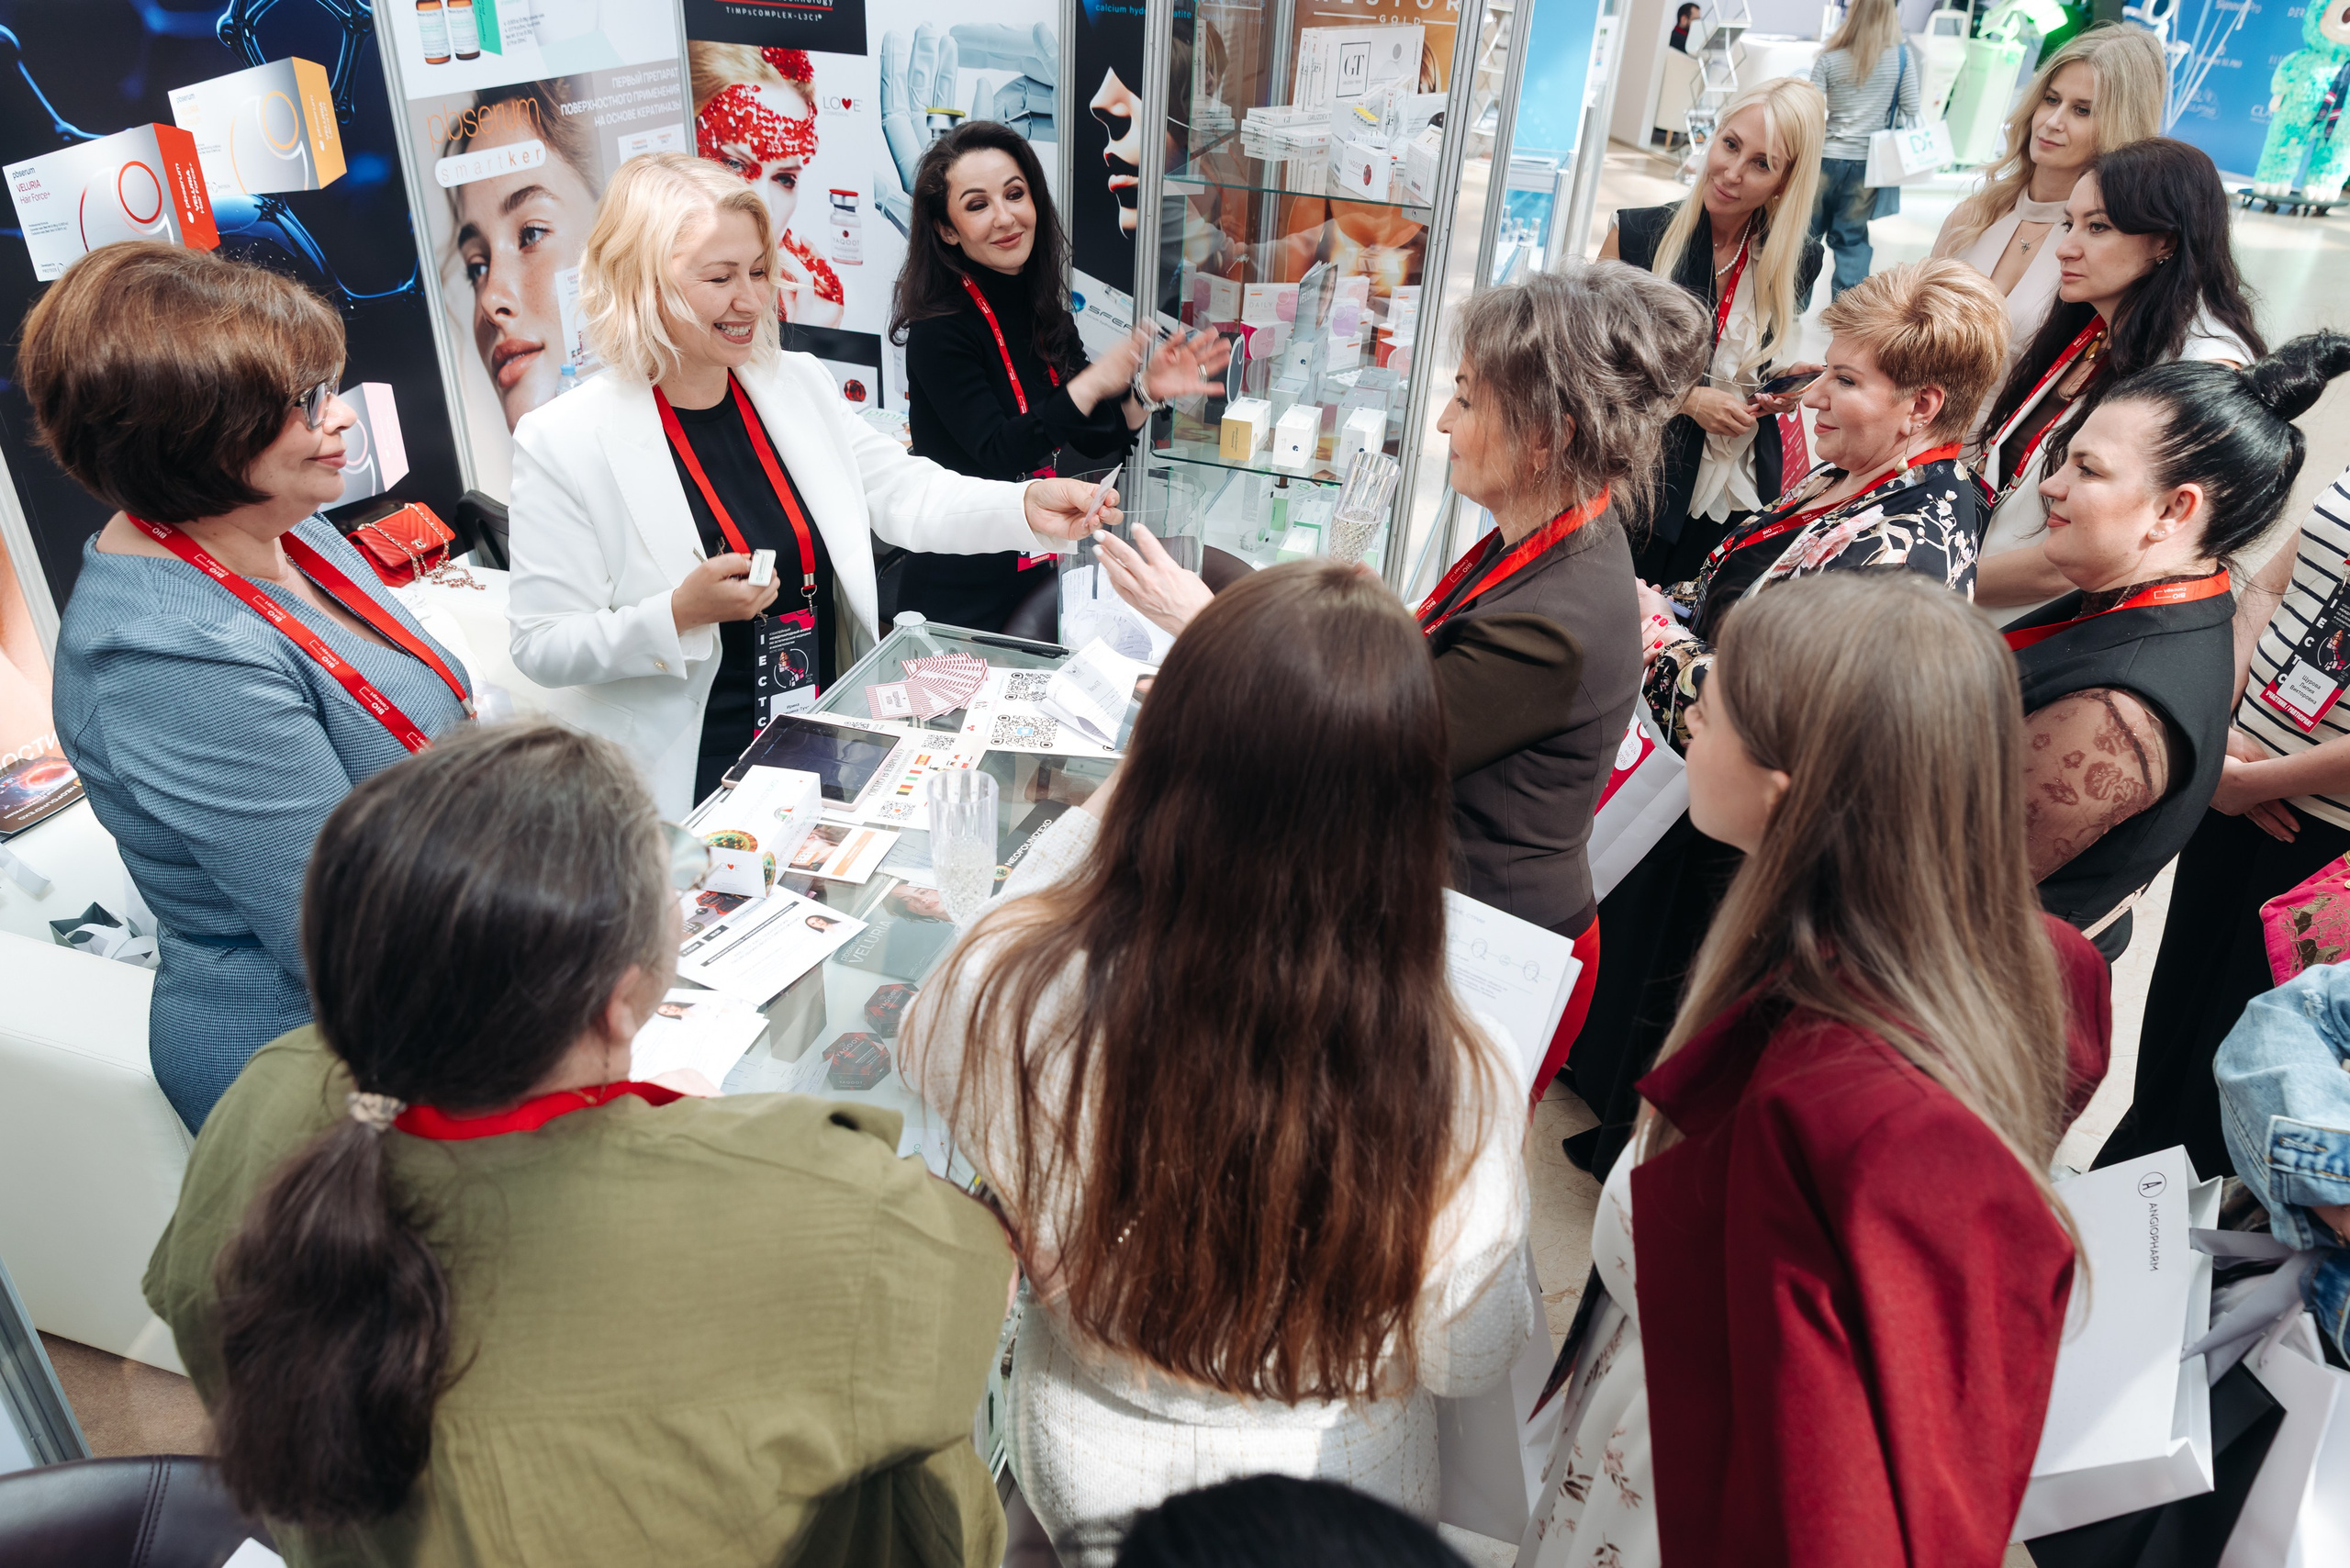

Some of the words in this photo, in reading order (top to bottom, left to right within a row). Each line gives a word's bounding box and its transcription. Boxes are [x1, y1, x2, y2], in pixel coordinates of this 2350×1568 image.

[1095, 5, 1127, 14] calcium
[1344, 55, 1365, 76] GT
[612, 72, 643, 89] ПЕРВЫЙ
[643, 67, 678, 84] ПРЕПАРАТ
[561, 91, 633, 117] ПОВЕРХНОСТНОГО
[633, 84, 680, 104] ПРИМЕНЕНИЯ
[594, 114, 606, 127] НА
[607, 107, 636, 125] ОСНОВЕ
[637, 100, 681, 119] КЕРАТИНАЗЫ
[427, 96, 541, 153] pbserum
[12, 166, 36, 180] pbserum
[442, 147, 541, 182] smartker
[17, 179, 42, 193] VELURIA
[174, 162, 192, 209] pbserum
[185, 169, 200, 211] VELURIA
[19, 194, 32, 205] Hair
[32, 191, 51, 203] Force+
[833, 237, 860, 247] YAQOOT
[2073, 337, 2082, 346] BIO
[152, 527, 167, 539] BIO
[1763, 531, 1779, 539] Concept
[207, 558, 229, 577] Concept
[209, 566, 226, 579] BIO
[1463, 562, 1472, 573] BIO
[264, 599, 286, 619] Concept
[1426, 600, 1437, 610] BIO
[267, 610, 283, 622] BIO
[319, 644, 340, 666] Concept
[321, 655, 336, 669] BIO
[2299, 682, 2315, 695] Лилия
[2301, 675, 2322, 690] Щурова
[370, 690, 389, 711] Concept
[2289, 684, 2318, 705] Викторовна
[371, 701, 385, 716] BIO
[2266, 689, 2287, 709] УЧАСТНИК
[2288, 706, 2314, 728] PARTICIPANT
[1004, 819, 1053, 867] NEOFOUND'EXO
[841, 935, 862, 962] pbserum
[848, 920, 894, 963] VELURIA
[879, 989, 898, 1009] YAQOOT
[835, 1036, 861, 1057] YAQOOT
[2149, 1203, 2159, 1271] ANGIOPHARM
